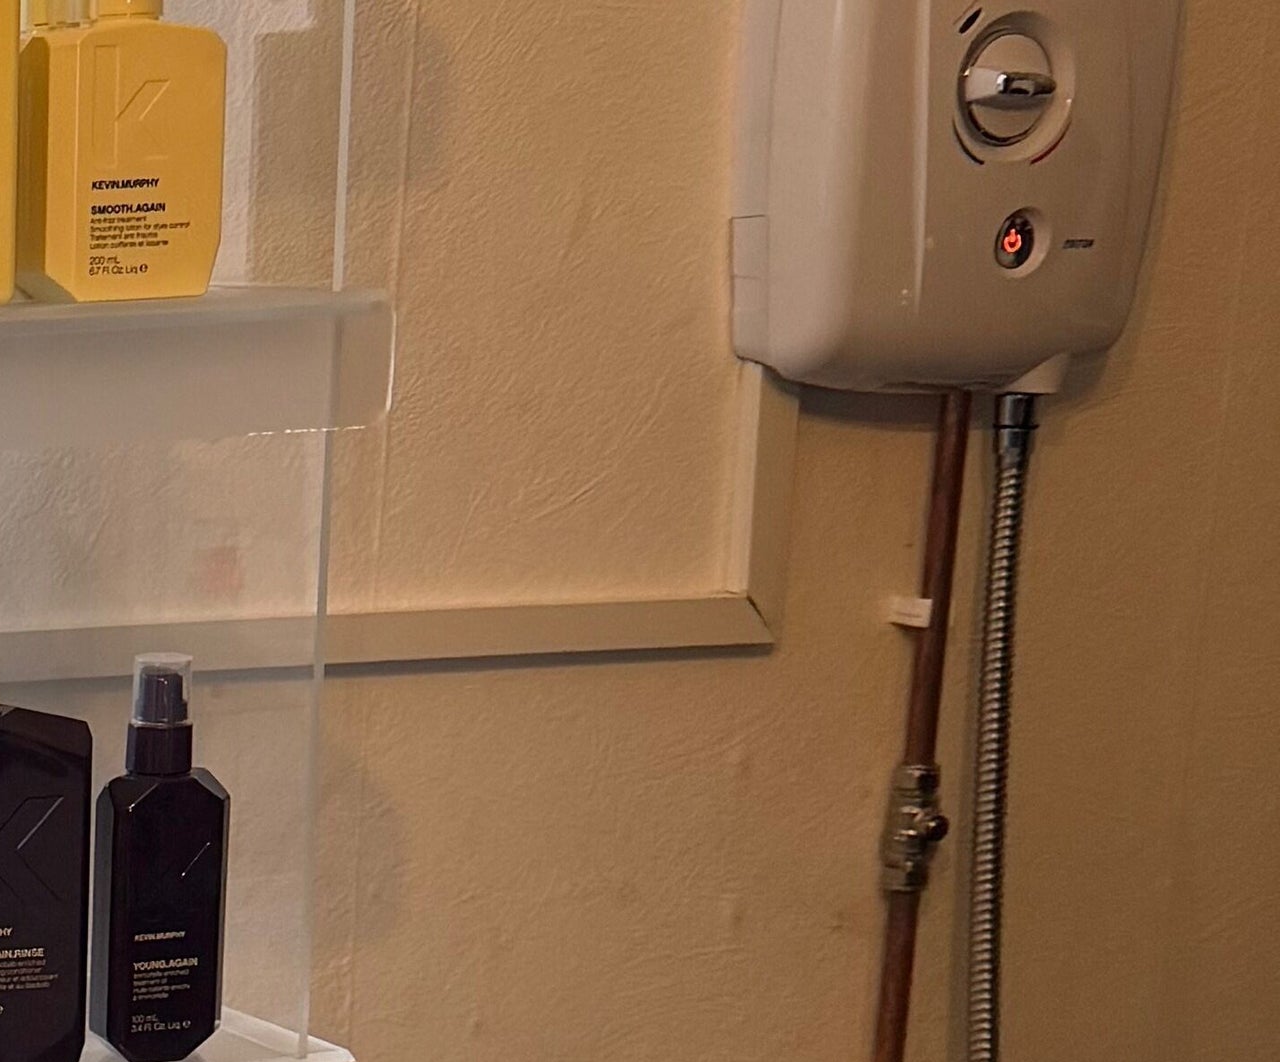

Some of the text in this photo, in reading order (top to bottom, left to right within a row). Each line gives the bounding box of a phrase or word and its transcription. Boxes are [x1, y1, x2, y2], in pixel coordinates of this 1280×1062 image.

[92, 178, 160, 190] KEVIN.MURPHY
[91, 203, 166, 215] SMOOTH.AGAIN
[133, 957, 198, 971] YOUNG.AGAIN
